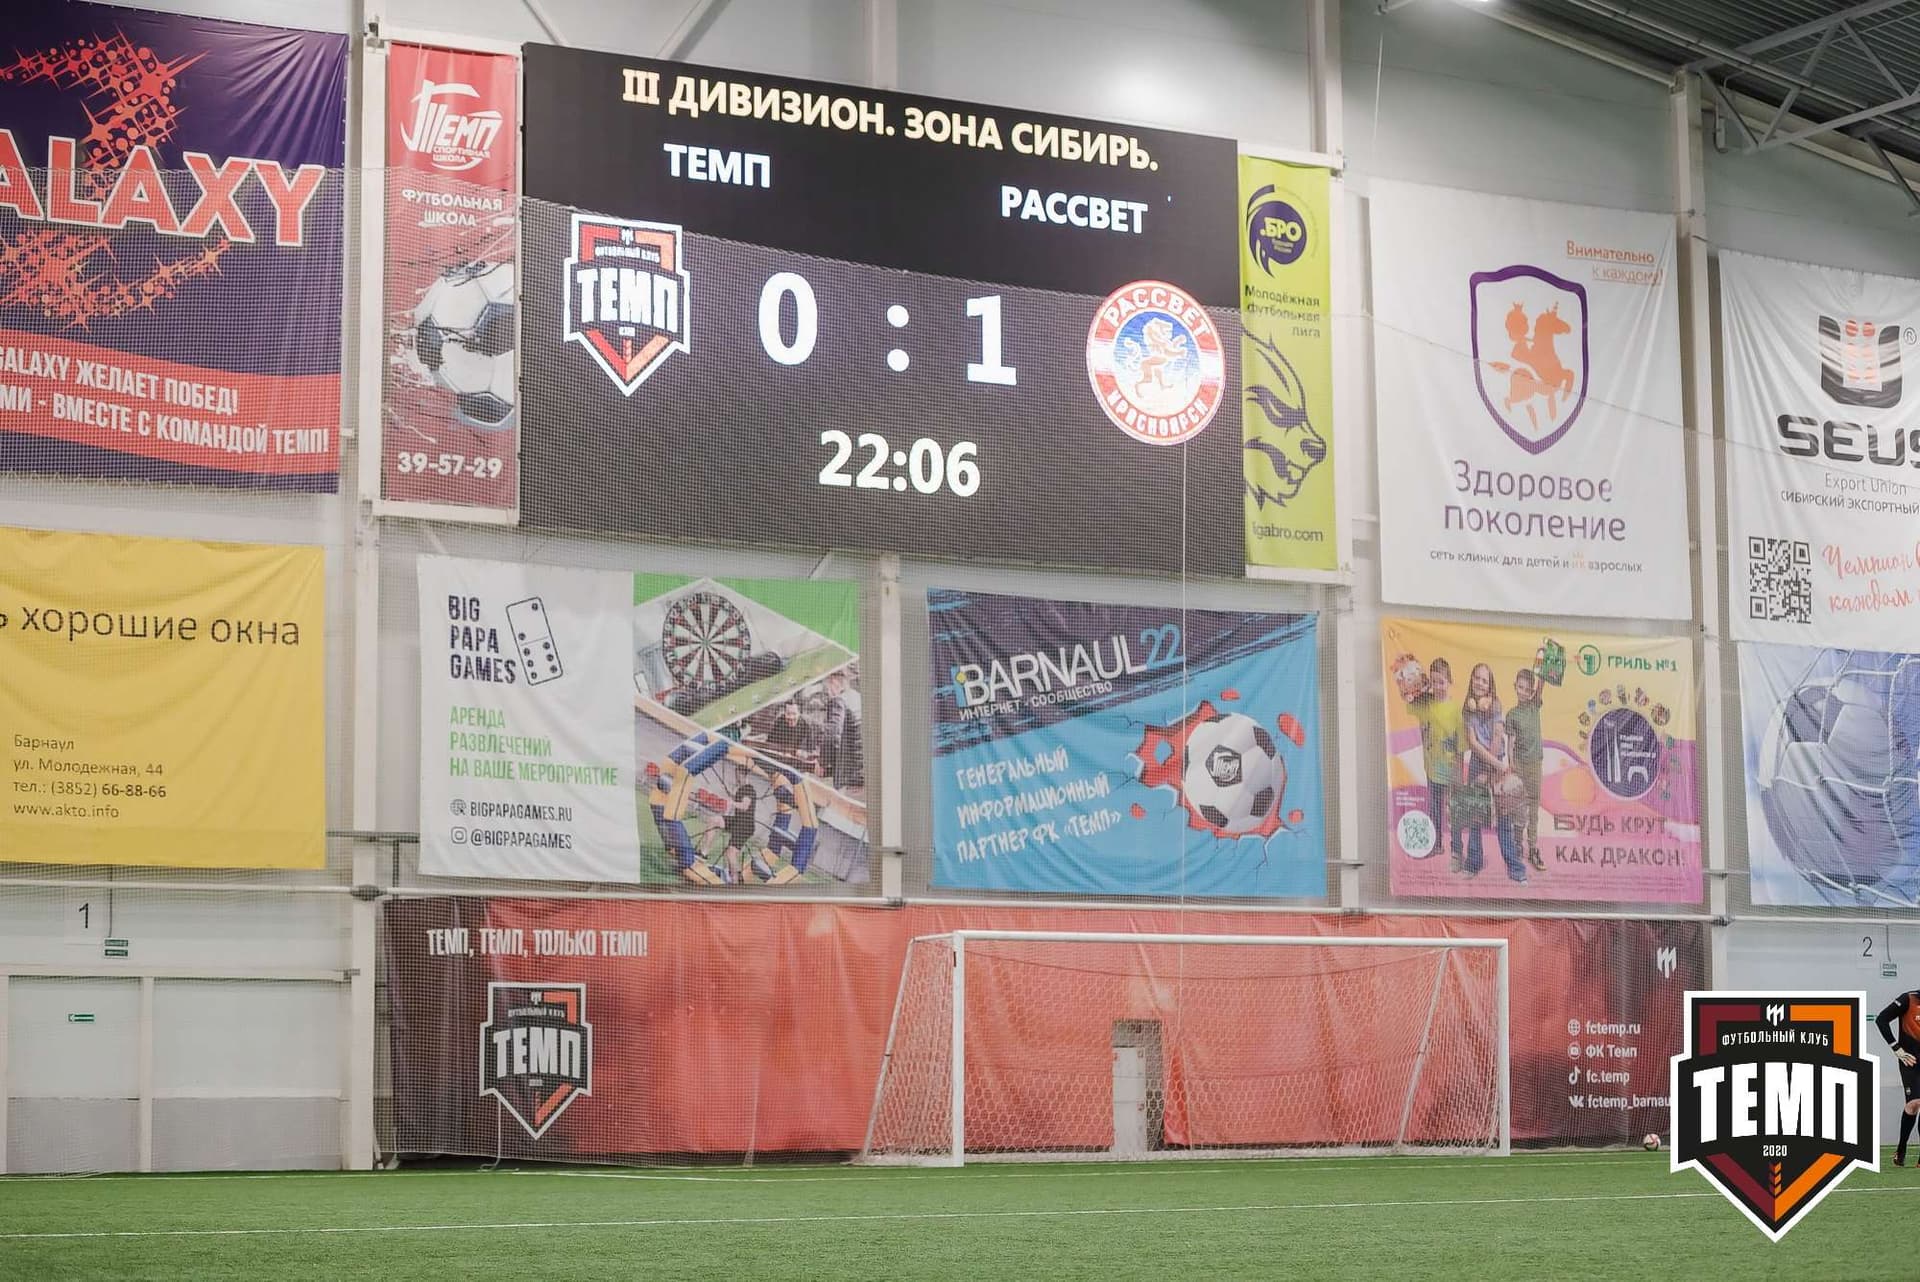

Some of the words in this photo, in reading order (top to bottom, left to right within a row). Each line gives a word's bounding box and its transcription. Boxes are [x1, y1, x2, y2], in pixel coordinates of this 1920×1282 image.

[668, 77, 894, 137] ДИВИЗИОН.
[904, 107, 1003, 151] ЗОНА
[1011, 122, 1159, 171] СИБИРЬ.
[663, 142, 771, 188] ТЕМП
[0, 128, 326, 247] ALAXY
[402, 188, 503, 211] ФУТБОЛЬНАЯ
[423, 210, 477, 227] ШКОЛА
[1001, 185, 1148, 234] РАССВЕТ
[1566, 240, 1655, 263] Внимательно
[577, 267, 679, 333] ТЕМП
[1245, 284, 1320, 307] Молодёжная
[1103, 287, 1211, 337] РАССВЕТ
[1247, 303, 1320, 322] футбольная
[759, 272, 818, 365] 0
[966, 295, 1017, 385] 1
[1292, 326, 1320, 338] лига
[76, 358, 161, 401] ЖЕЛАЕТ
[165, 378, 239, 415] ПОБЕД!
[53, 392, 131, 437] ВМЕСТЕ
[138, 411, 150, 437] С
[156, 422, 269, 455] КОМАНДОЙ
[272, 427, 330, 455] ТЕМП!
[1777, 414, 1920, 469] SEU
[398, 452, 502, 478] 39-57-29
[818, 429, 981, 497] 22:06
[1454, 459, 1613, 503] Здоровое
[1825, 472, 1867, 491] Export
[1870, 477, 1907, 496] Union
[1781, 489, 1845, 508] СИБИРСКИЙ
[1848, 497, 1920, 515] ЭКСПОРТНЫЙ
[1444, 503, 1626, 542] поколение
[1430, 549, 1455, 560] сеть
[1457, 551, 1499, 565] клиник
[1502, 554, 1523, 567] для
[1526, 555, 1560, 569] детей
[1563, 559, 1570, 569] и
[1588, 559, 1643, 574] взрослых
[448, 594, 480, 622] BIG
[22, 606, 197, 642] хорошие
[211, 617, 299, 645] окна
[450, 625, 499, 654] PAPA
[450, 654, 516, 684] GAMES
[1607, 655, 1652, 671] ГРИЛЬ
[1655, 660, 1678, 672] №1
[450, 705, 506, 729] АРЕНДА
[14, 734, 75, 751] Барнаул
[450, 731, 553, 757] РАЗВЛЕЧЕНИЙ
[13, 759, 34, 772] ул.
[38, 758, 141, 777] Молодежная,
[145, 763, 164, 776] 44
[450, 757, 470, 777] НА
[474, 758, 516, 781] ВАШЕ
[519, 762, 619, 786] МЕРОПРИЯТИЕ
[956, 744, 1070, 791] ГЕНЕРАЛЬНЫЙ
[13, 781, 46, 794] тел.:
[51, 780, 98, 798] (3852)
[102, 783, 167, 798] 66-88-66
[956, 771, 1111, 829] ИНФОРМАЦИОННЫЙ
[13, 803, 120, 818] www.akto.info
[470, 801, 573, 822] BIGPAPAGAMES.RU
[956, 828, 1029, 864] ПАРТНЕР
[1032, 821, 1061, 845] ФК
[1064, 808, 1122, 838] «ТЕМП»
[1553, 813, 1615, 836] БУДЬ
[470, 828, 573, 850] @BIGPAPAGAMES
[1555, 845, 1595, 864] КАК
[79, 902, 89, 929] 1
[426, 927, 474, 958] ТЕМП,
[479, 927, 528, 958] ТЕМП,
[533, 928, 597, 957] ТОЛЬКО
[600, 929, 648, 957] ТЕМП!
[1862, 936, 1873, 957] 2
[1586, 1020, 1641, 1037] fctemp.ru
[493, 1026, 580, 1079] ТЕМП
[1586, 1044, 1605, 1059] ФК
[1607, 1044, 1638, 1059] Темп
[1586, 1069, 1630, 1086] fc.temp
